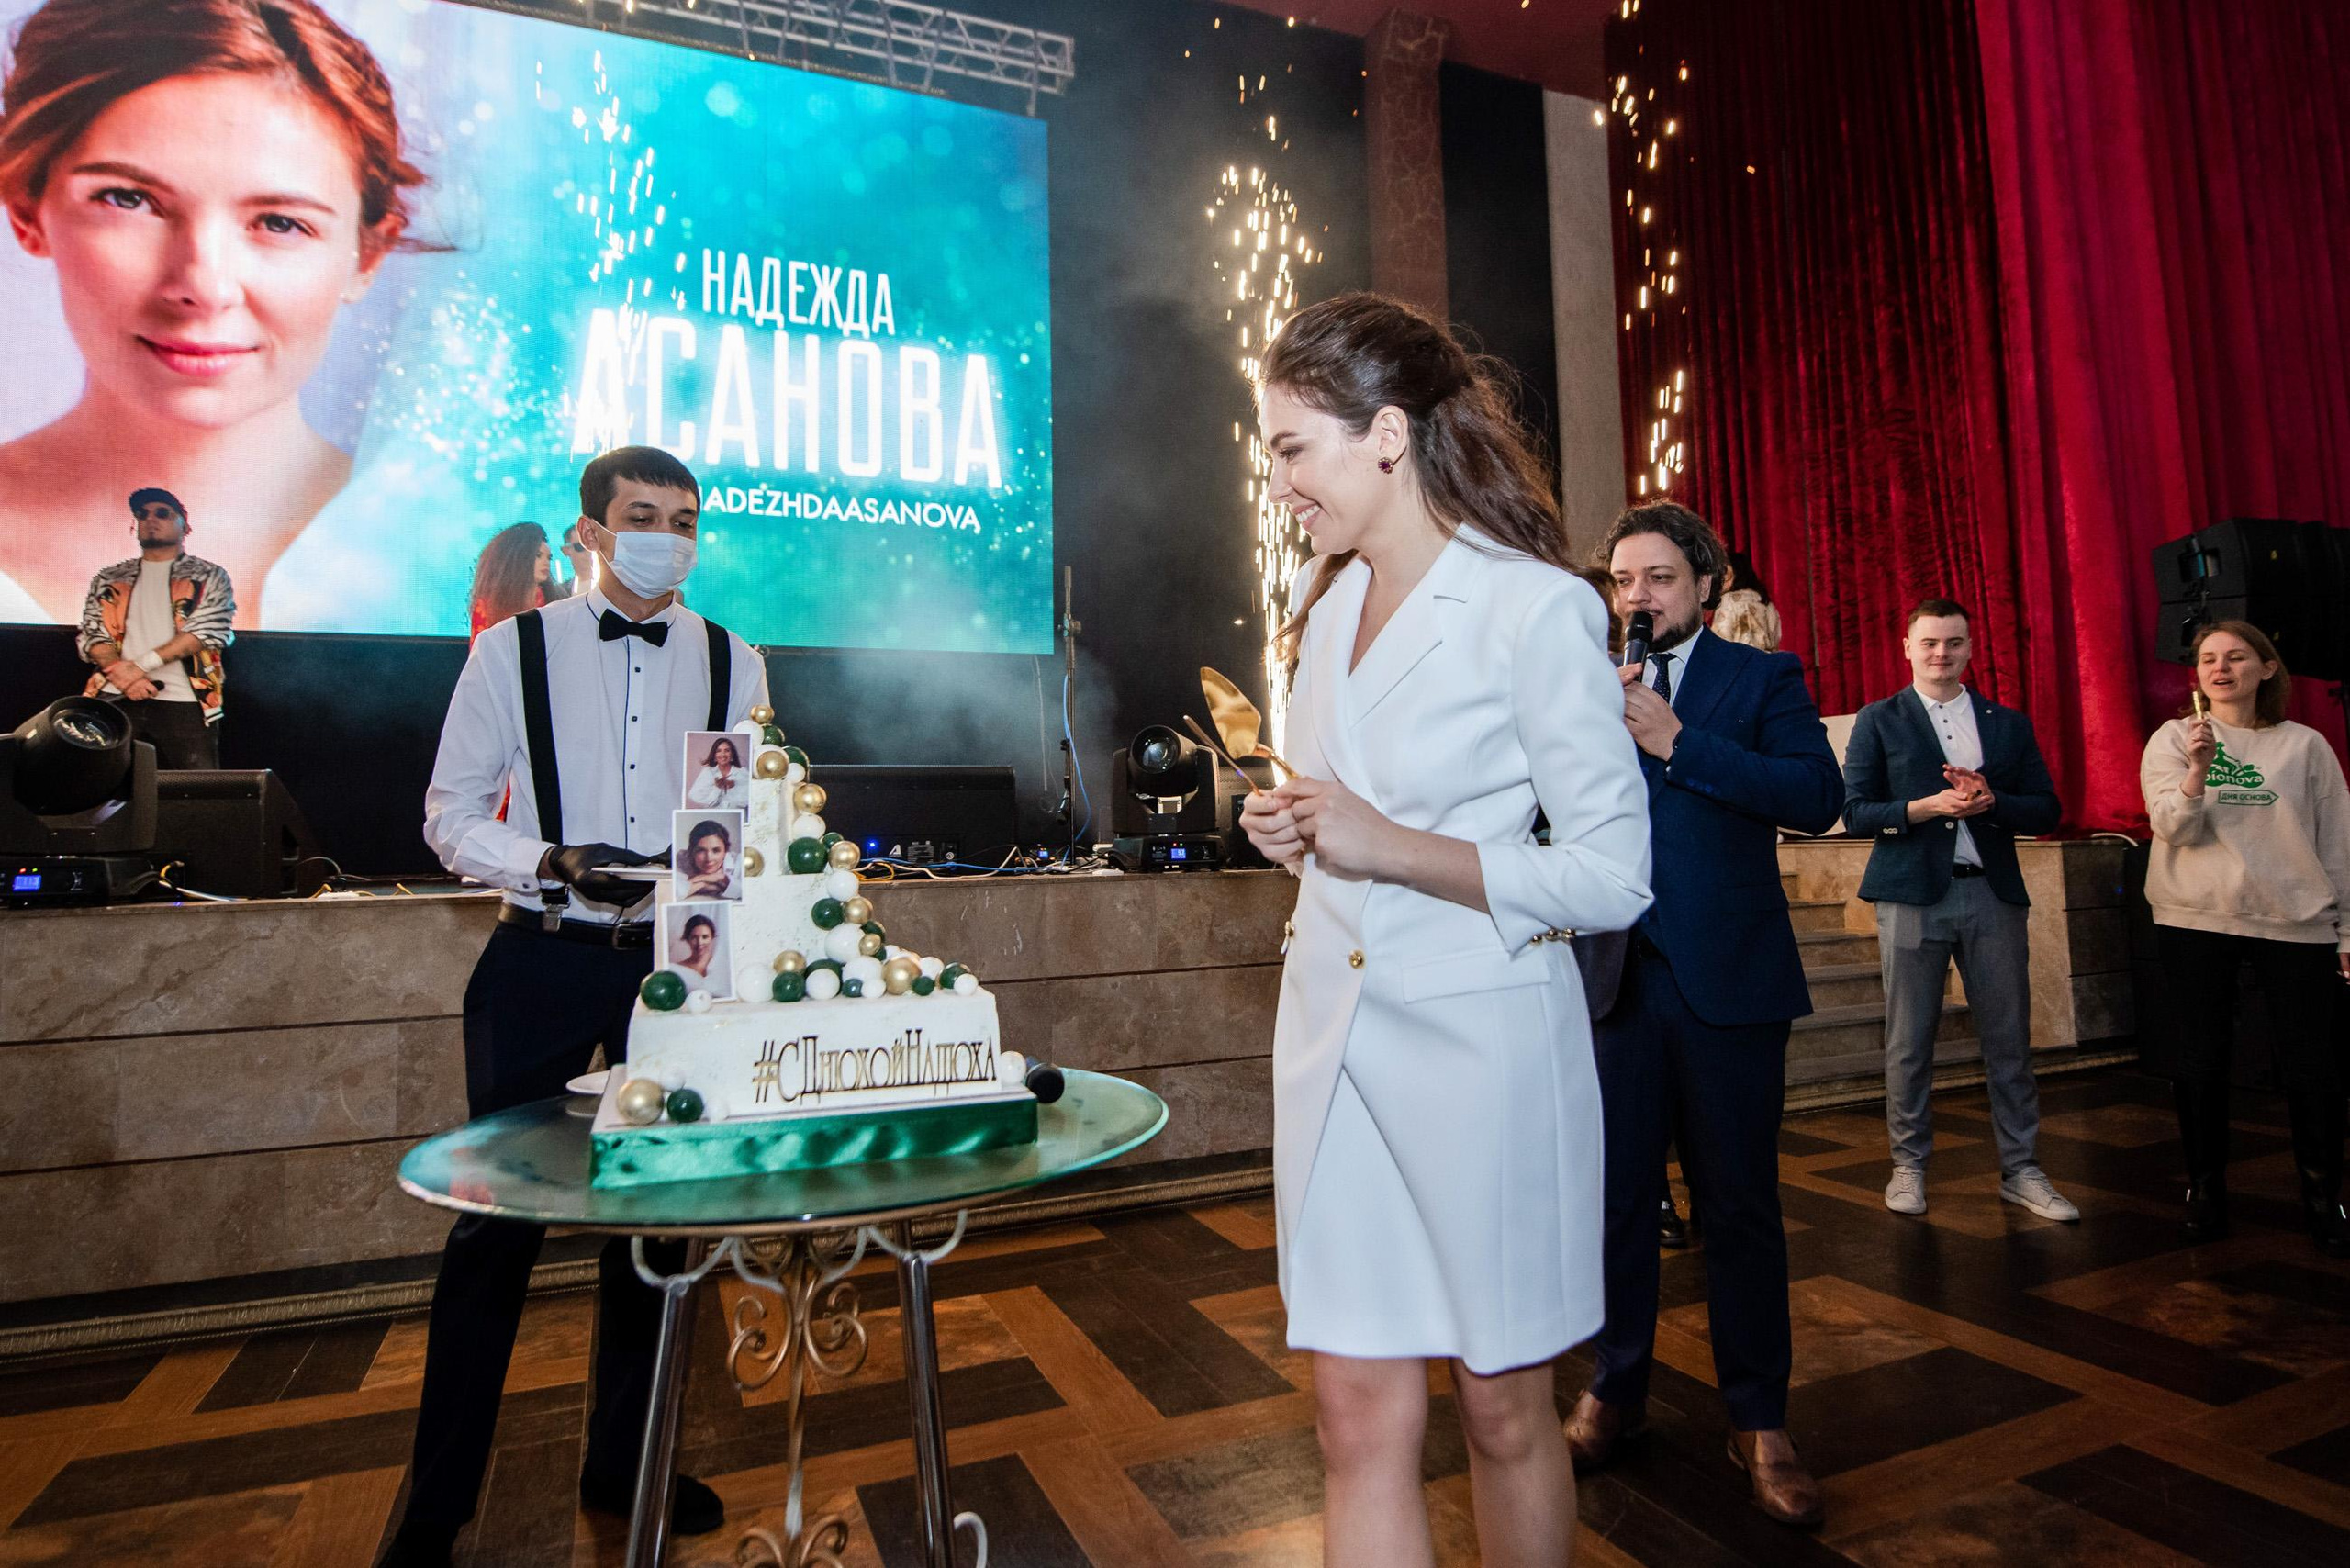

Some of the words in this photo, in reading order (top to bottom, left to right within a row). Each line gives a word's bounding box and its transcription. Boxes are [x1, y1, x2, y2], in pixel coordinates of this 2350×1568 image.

[701, 248, 896, 339] НАДЕЖДА
[571, 308, 1002, 488] АСАНОВА
[698, 484, 981, 534] ADEZHDAASANOVA
